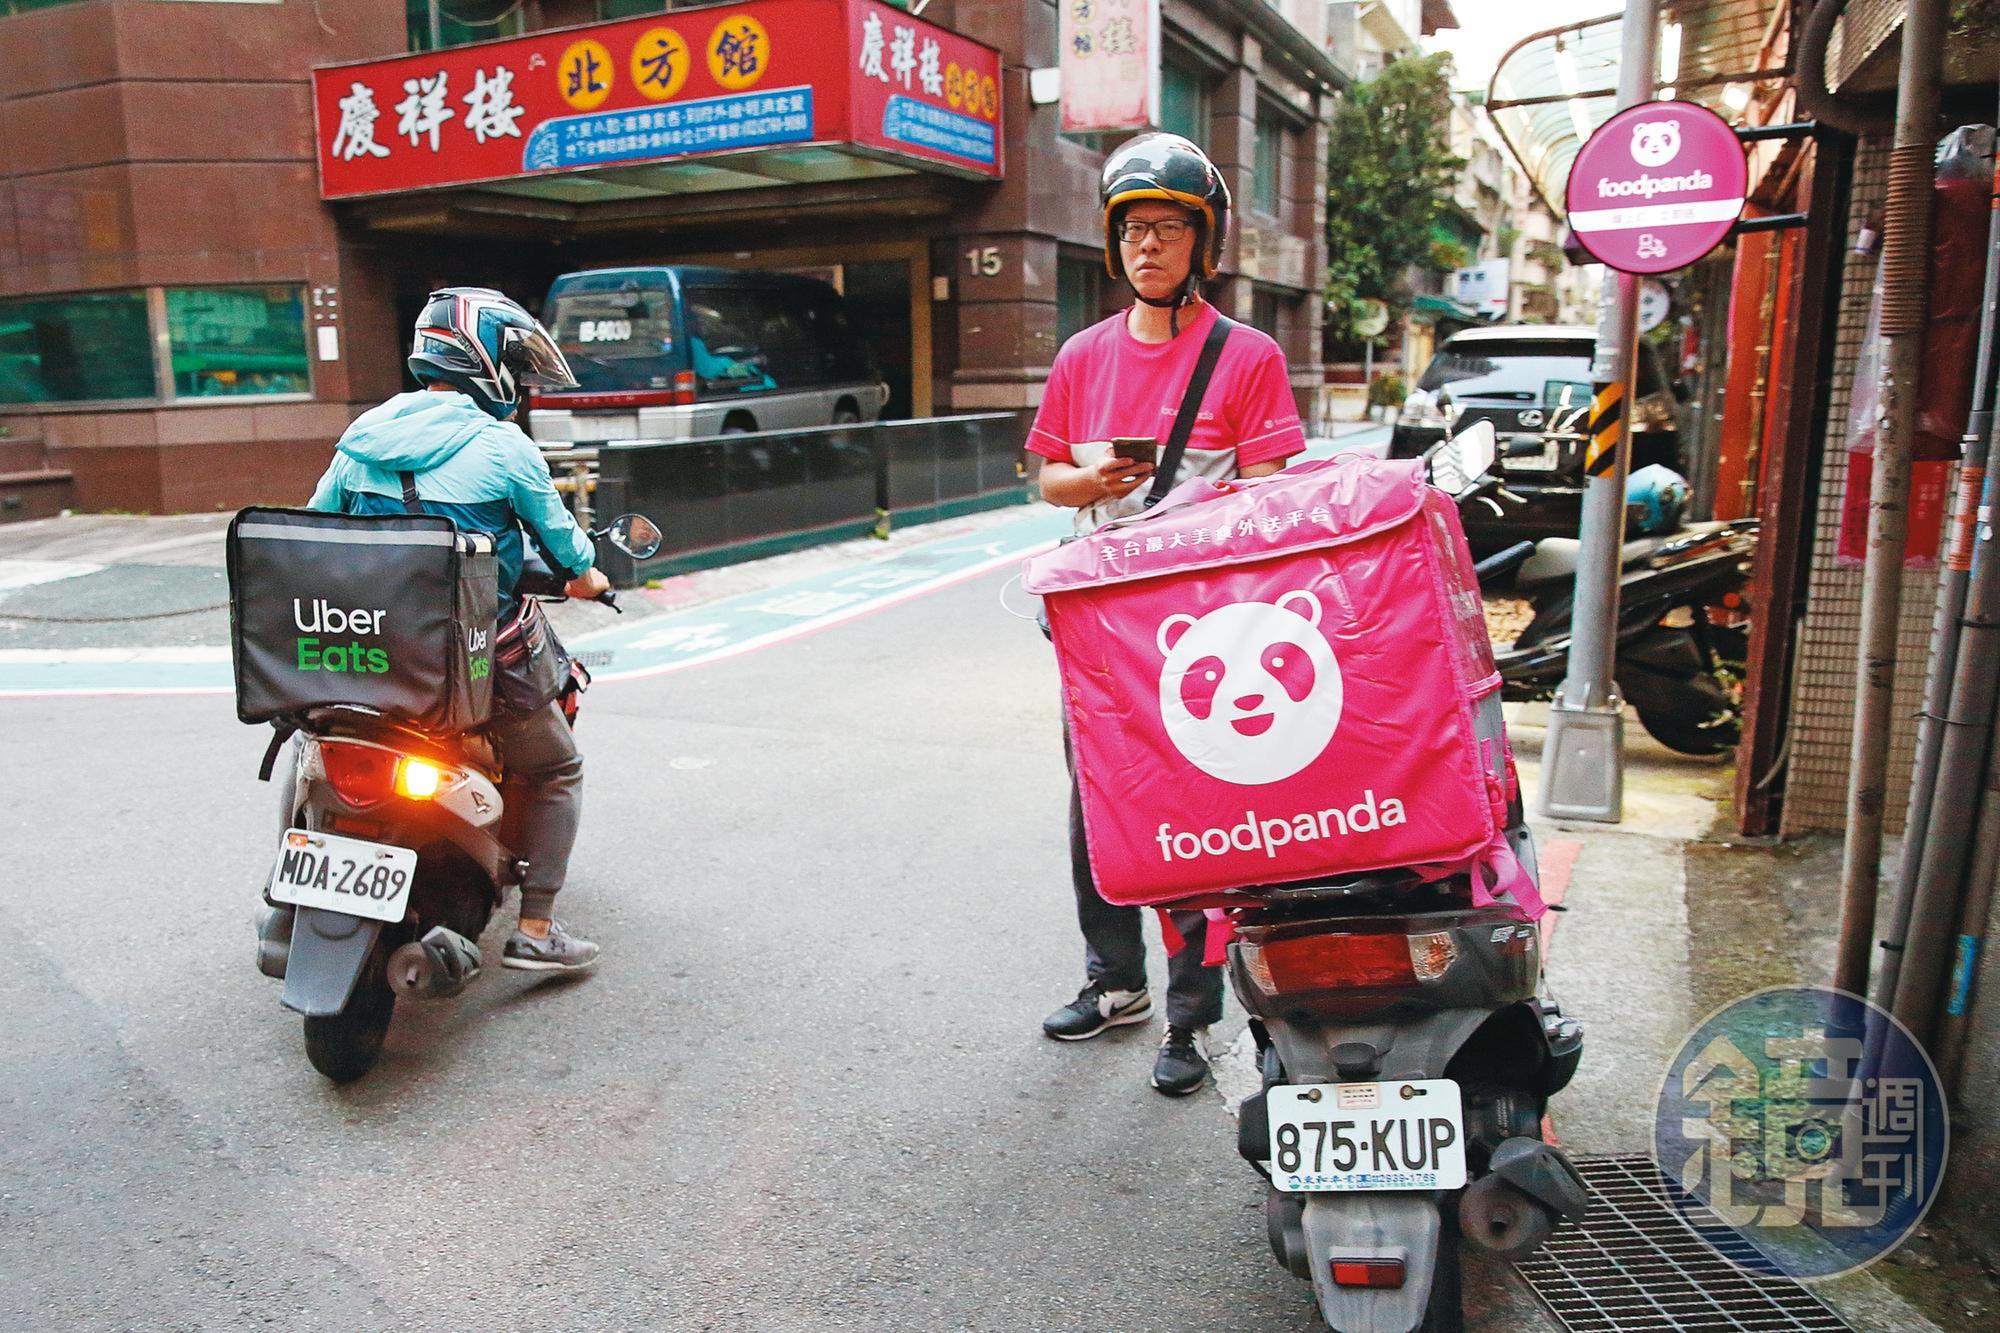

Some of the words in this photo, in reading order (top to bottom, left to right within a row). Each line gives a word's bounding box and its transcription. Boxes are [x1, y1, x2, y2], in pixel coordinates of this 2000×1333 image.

[565, 23, 762, 98] 北方館
[859, 10, 943, 98] 慶祥樓
[332, 65, 526, 161] 慶祥樓
[1597, 169, 1713, 199] foodpanda
[965, 246, 1002, 276] 15
[1101, 506, 1331, 562] 全台最大美食外送平台
[293, 597, 387, 635] Uber
[468, 627, 488, 652] Uber
[296, 637, 390, 674] Eats
[1155, 789, 1407, 863] foodpanda
[278, 848, 408, 902] MDA-2689
[1276, 1117, 1456, 1174] 875-KUP
